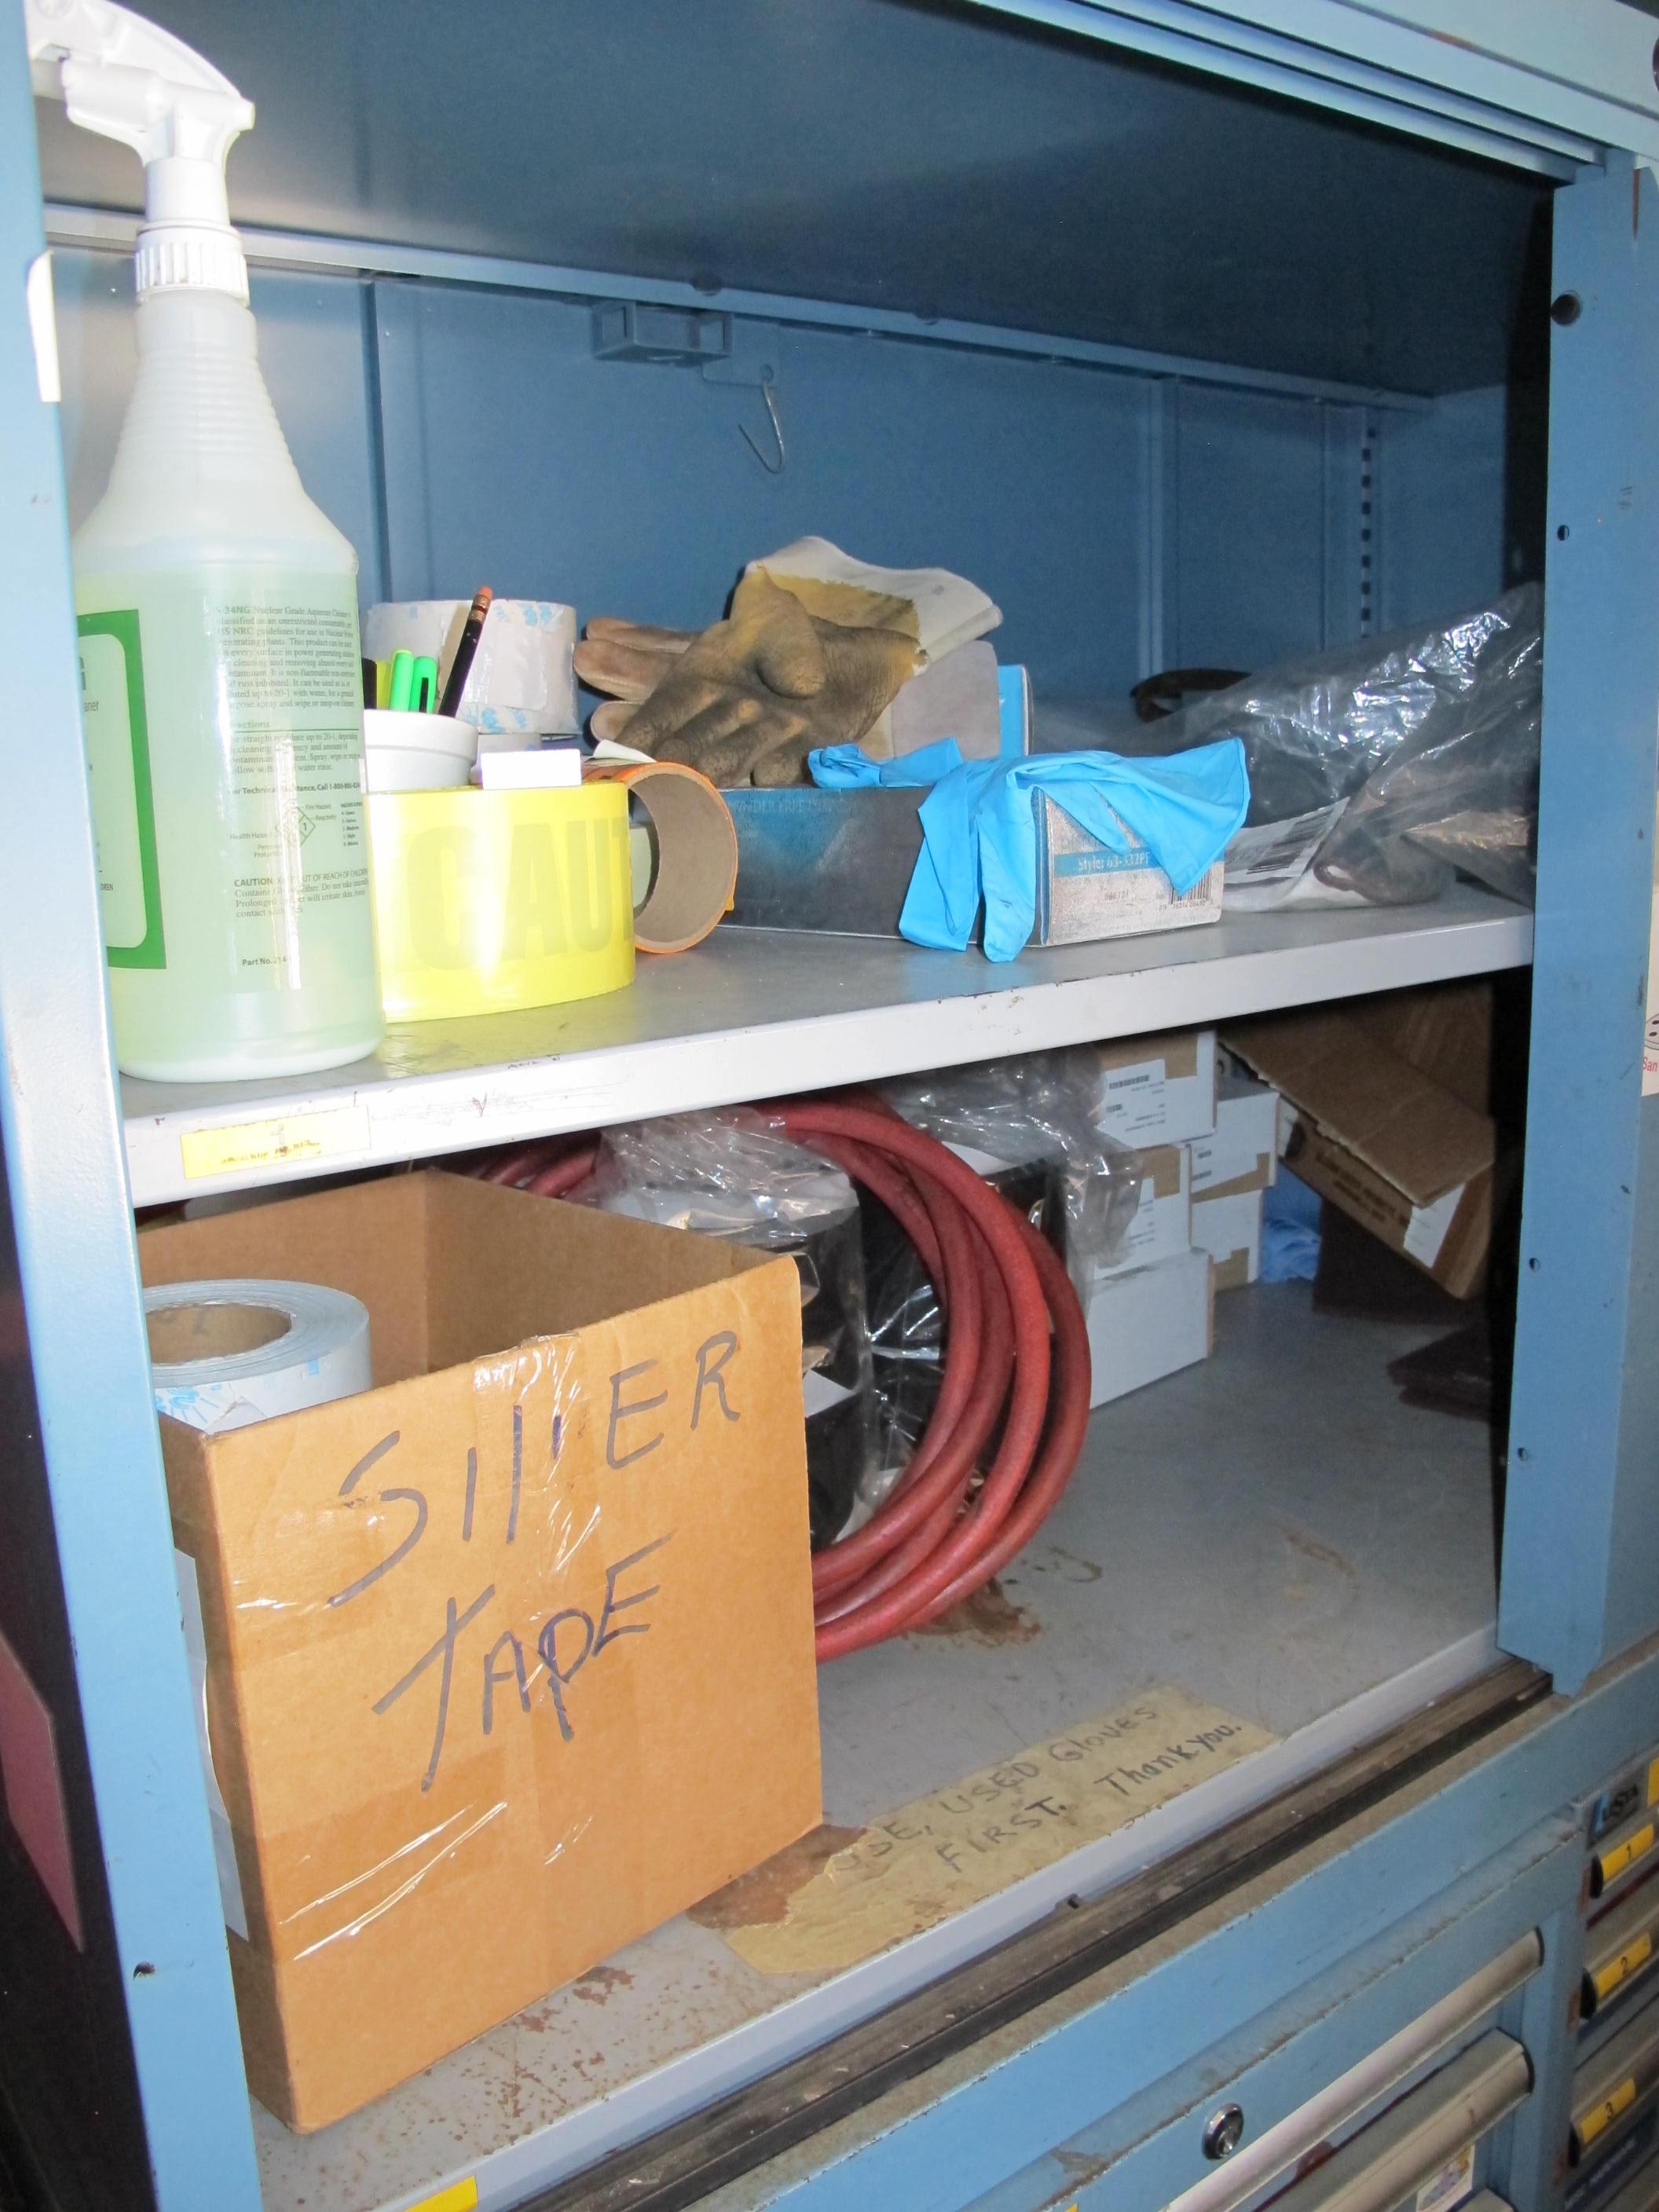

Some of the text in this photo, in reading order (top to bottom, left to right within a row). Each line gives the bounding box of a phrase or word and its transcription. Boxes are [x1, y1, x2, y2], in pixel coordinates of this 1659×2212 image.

[284, 606, 306, 615] Grade
[232, 627, 254, 635] NRC
[288, 637, 305, 646] This
[230, 650, 252, 659] every
[294, 650, 314, 658] power
[269, 658, 284, 667] and
[284, 659, 316, 668] removing
[227, 669, 268, 678] ntaminant.
[228, 689, 251, 698] luted
[273, 689, 291, 698] 20-1
[292, 689, 309, 698] with
[83, 701, 99, 712] aner
[295, 700, 312, 709] wipe
[229, 720, 272, 730] rections
[242, 734, 273, 745] straight
[306, 734, 315, 744] up
[237, 745, 273, 755] cleaning
[232, 756, 275, 765] ontaminan
[298, 764, 318, 772] water
[317, 782, 328, 791] Call
[302, 822, 308, 831] 1
[230, 831, 251, 840] Health
[1077, 853, 1104, 872] Style:
[313, 872, 322, 881] OF
[322, 871, 342, 881] REACH
[342, 870, 350, 879] OF
[235, 887, 272, 899] Contains
[321, 881, 331, 891] Do
[332, 881, 342, 890] not
[236, 897, 277, 909] Prolonged
[306, 892, 320, 903] will
[236, 908, 266, 919] contact
[241, 958, 259, 968] Part
[372, 1527, 677, 1793] TAPE
[1093, 1743, 1200, 1797] Thank
[939, 1761, 1041, 1815] USED
[1624, 1841, 1634, 1861] 1
[1620, 1956, 1630, 1974] 2
[1605, 2101, 1614, 2119] 3
